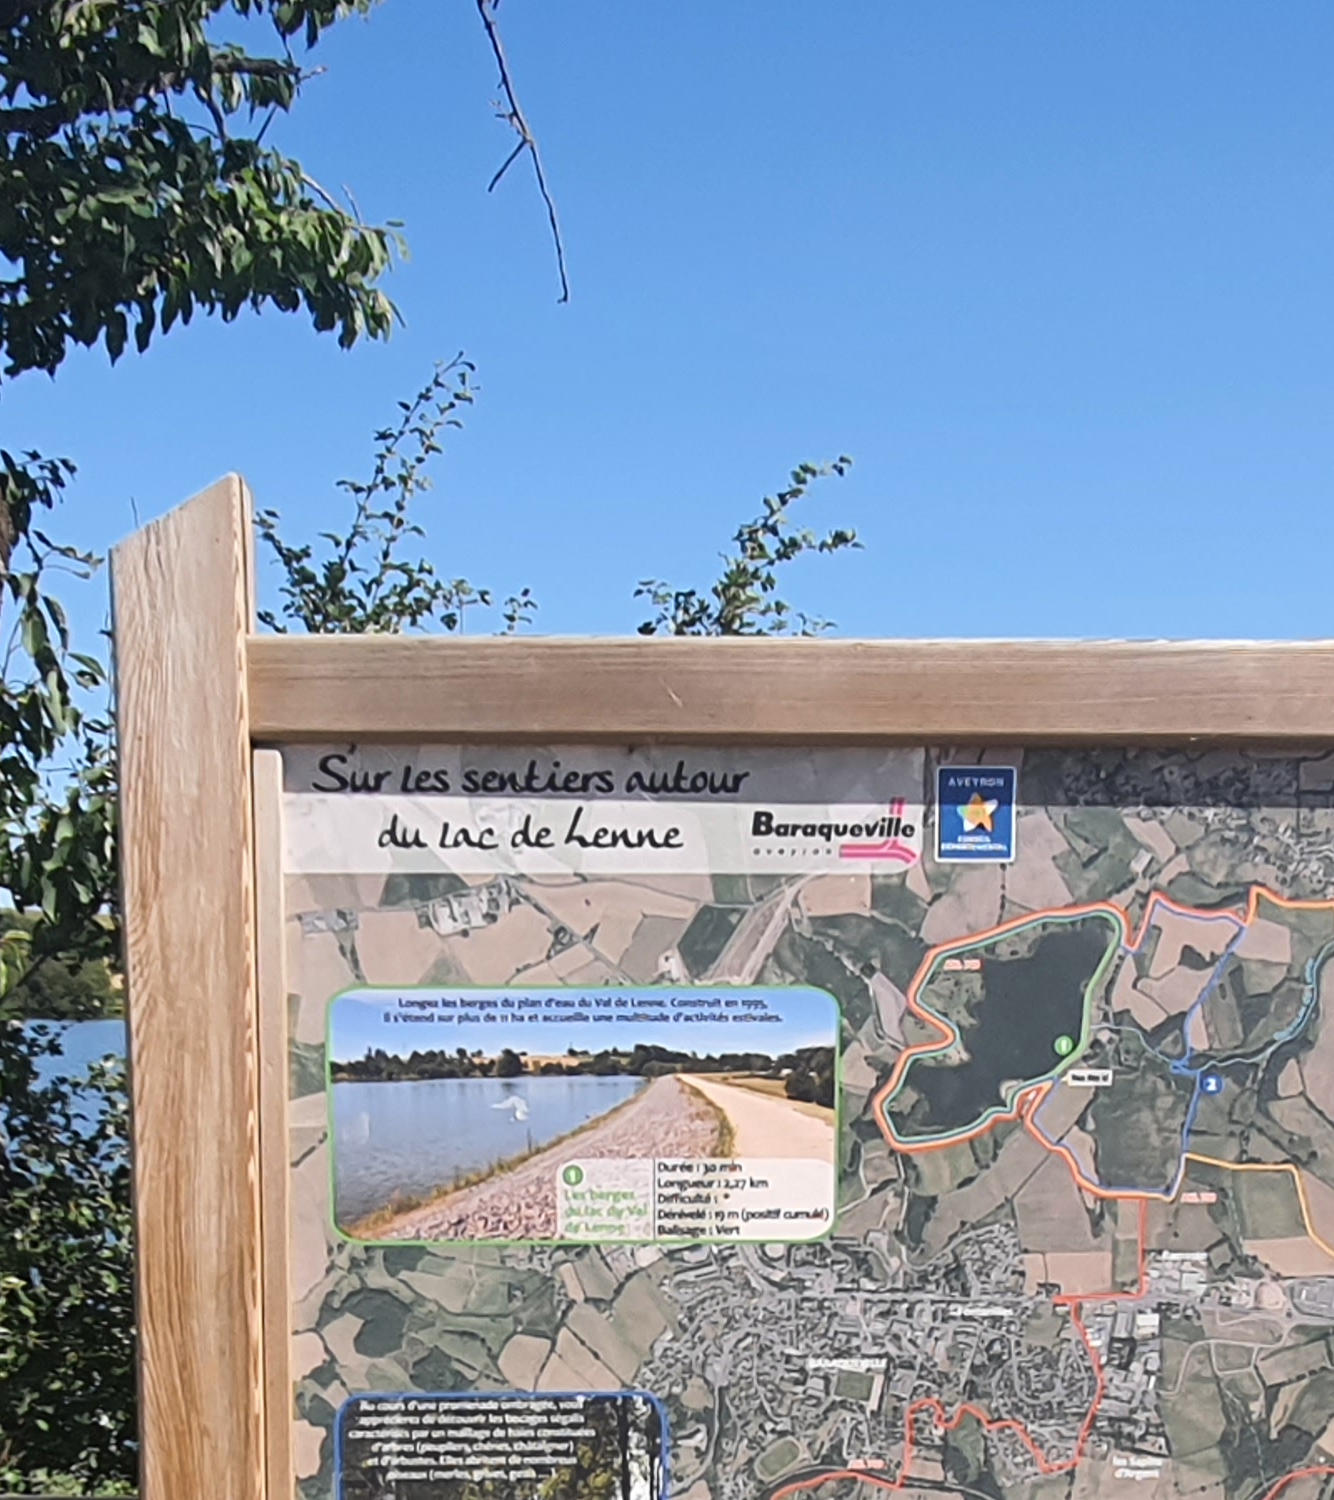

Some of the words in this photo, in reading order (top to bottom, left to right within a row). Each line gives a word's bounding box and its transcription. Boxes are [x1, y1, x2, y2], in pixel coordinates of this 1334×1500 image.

[312, 751, 393, 793] Sur
[401, 765, 451, 793] les
[461, 759, 615, 793] sentiers
[625, 759, 750, 794] autour
[948, 777, 1005, 787] AVEYRON
[378, 814, 428, 849] du
[439, 822, 499, 850] lac
[511, 814, 554, 849] de
[564, 805, 685, 849] Lenne
[752, 811, 915, 841] Baraqueville
[398, 998, 438, 1010] Longez
[442, 998, 457, 1007] les
[501, 998, 515, 1007] du
[518, 998, 541, 1010] plan
[578, 998, 592, 1007] du
[595, 998, 611, 1007] Val
[614, 998, 628, 1007] de
[670, 997, 721, 1007] Construit
[483, 1013, 496, 1022] de
[658, 1162, 693, 1172] Durée
[720, 1163, 742, 1172] min
[658, 1179, 714, 1191] Longueur
[750, 1177, 768, 1188] km
[658, 1193, 710, 1204] Difficulté
[741, 1208, 781, 1222] (positif
[784, 1208, 830, 1222] cumulé)
[658, 1225, 706, 1238] Balisage
[715, 1225, 741, 1235] Vert
